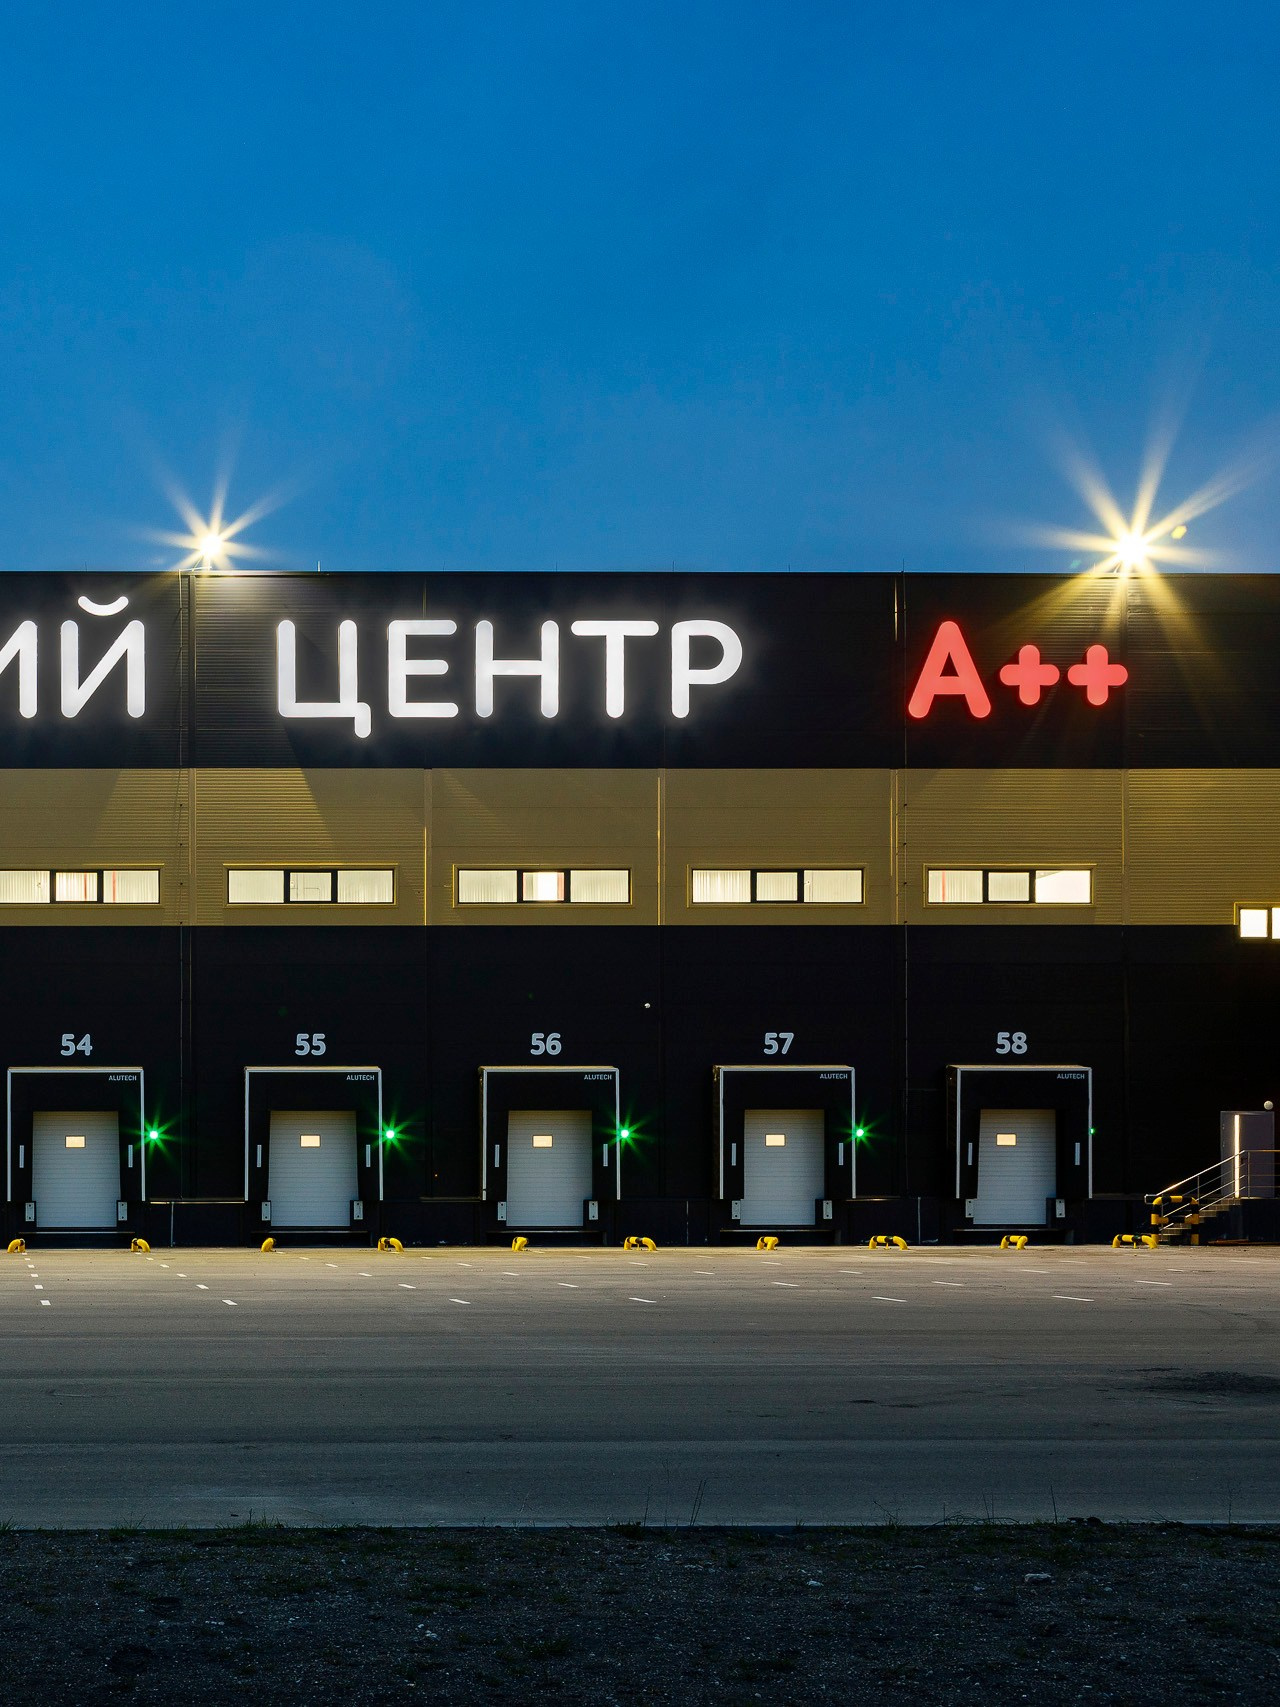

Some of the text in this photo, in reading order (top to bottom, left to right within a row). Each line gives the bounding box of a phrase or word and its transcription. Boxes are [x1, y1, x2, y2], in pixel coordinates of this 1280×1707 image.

[277, 619, 743, 739] ЦЕНТР
[61, 1034, 93, 1056] 54
[295, 1033, 327, 1055] 55
[531, 1033, 562, 1055] 56
[764, 1033, 795, 1055] 57
[996, 1032, 1028, 1054] 58
